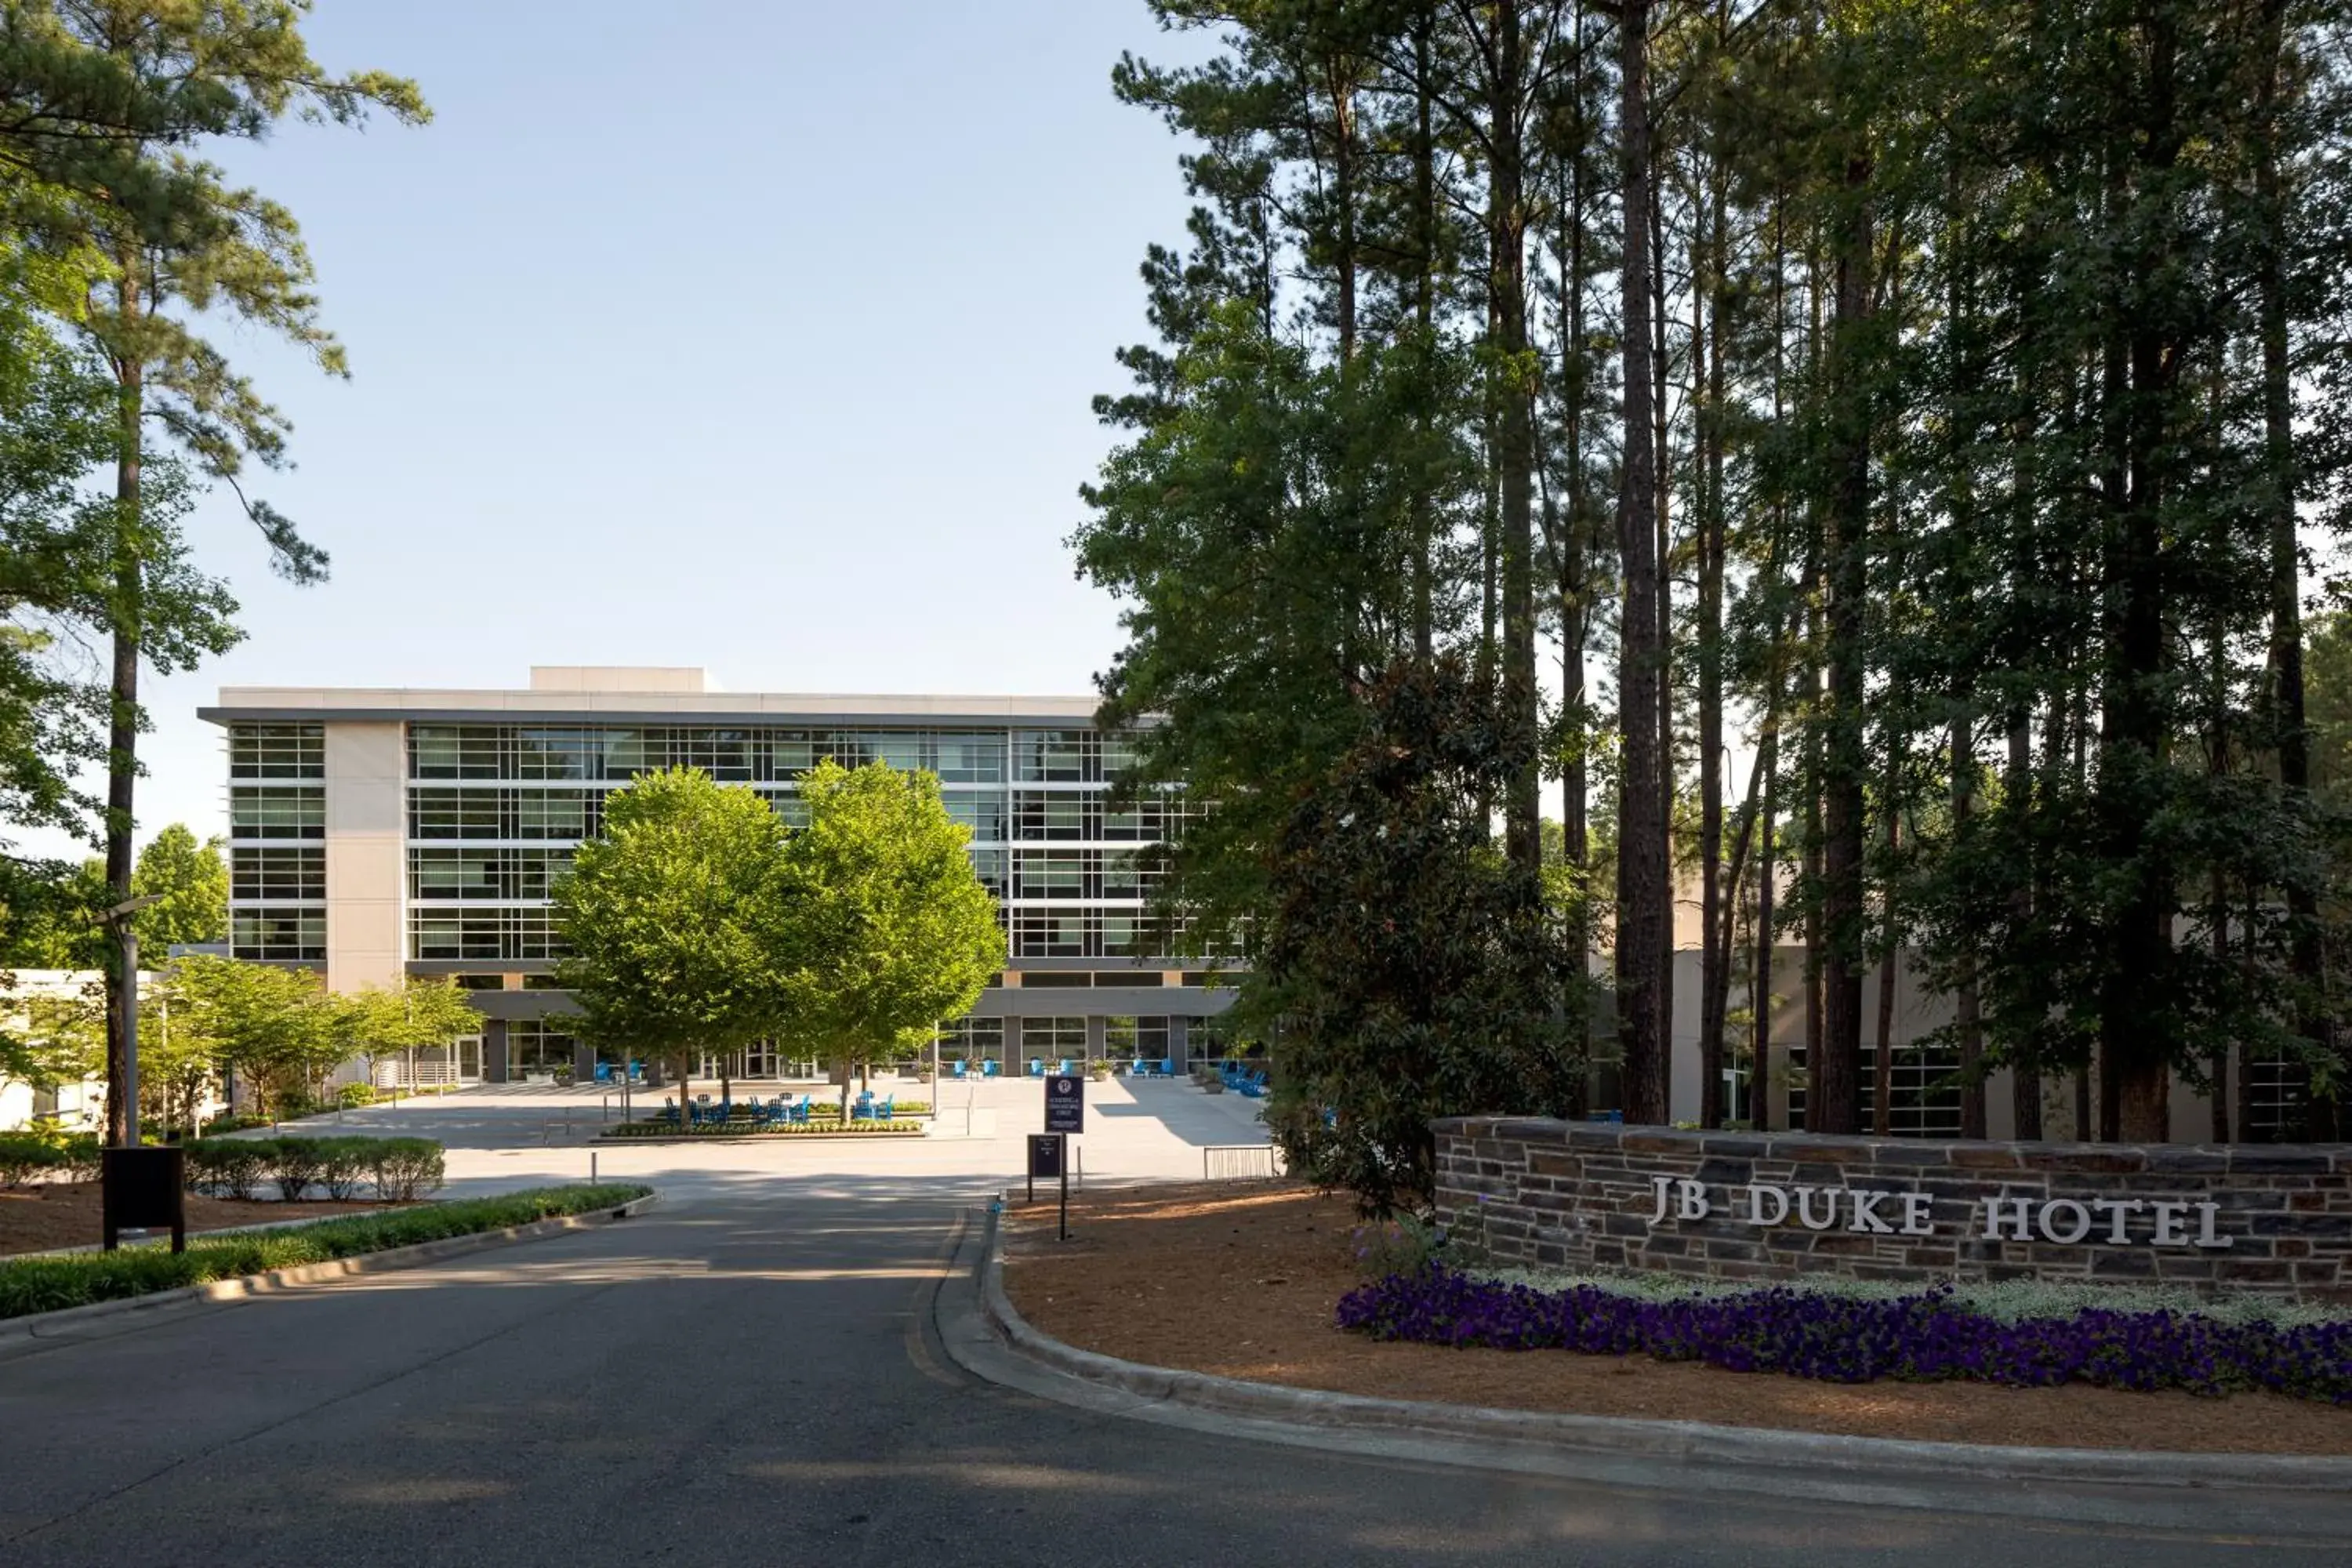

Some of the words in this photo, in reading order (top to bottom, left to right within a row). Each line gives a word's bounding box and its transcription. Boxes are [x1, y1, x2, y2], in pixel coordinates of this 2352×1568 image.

[1650, 1177, 1710, 1225] JB
[1748, 1185, 1934, 1235] DUKE
[1980, 1196, 2234, 1247] HOTEL
